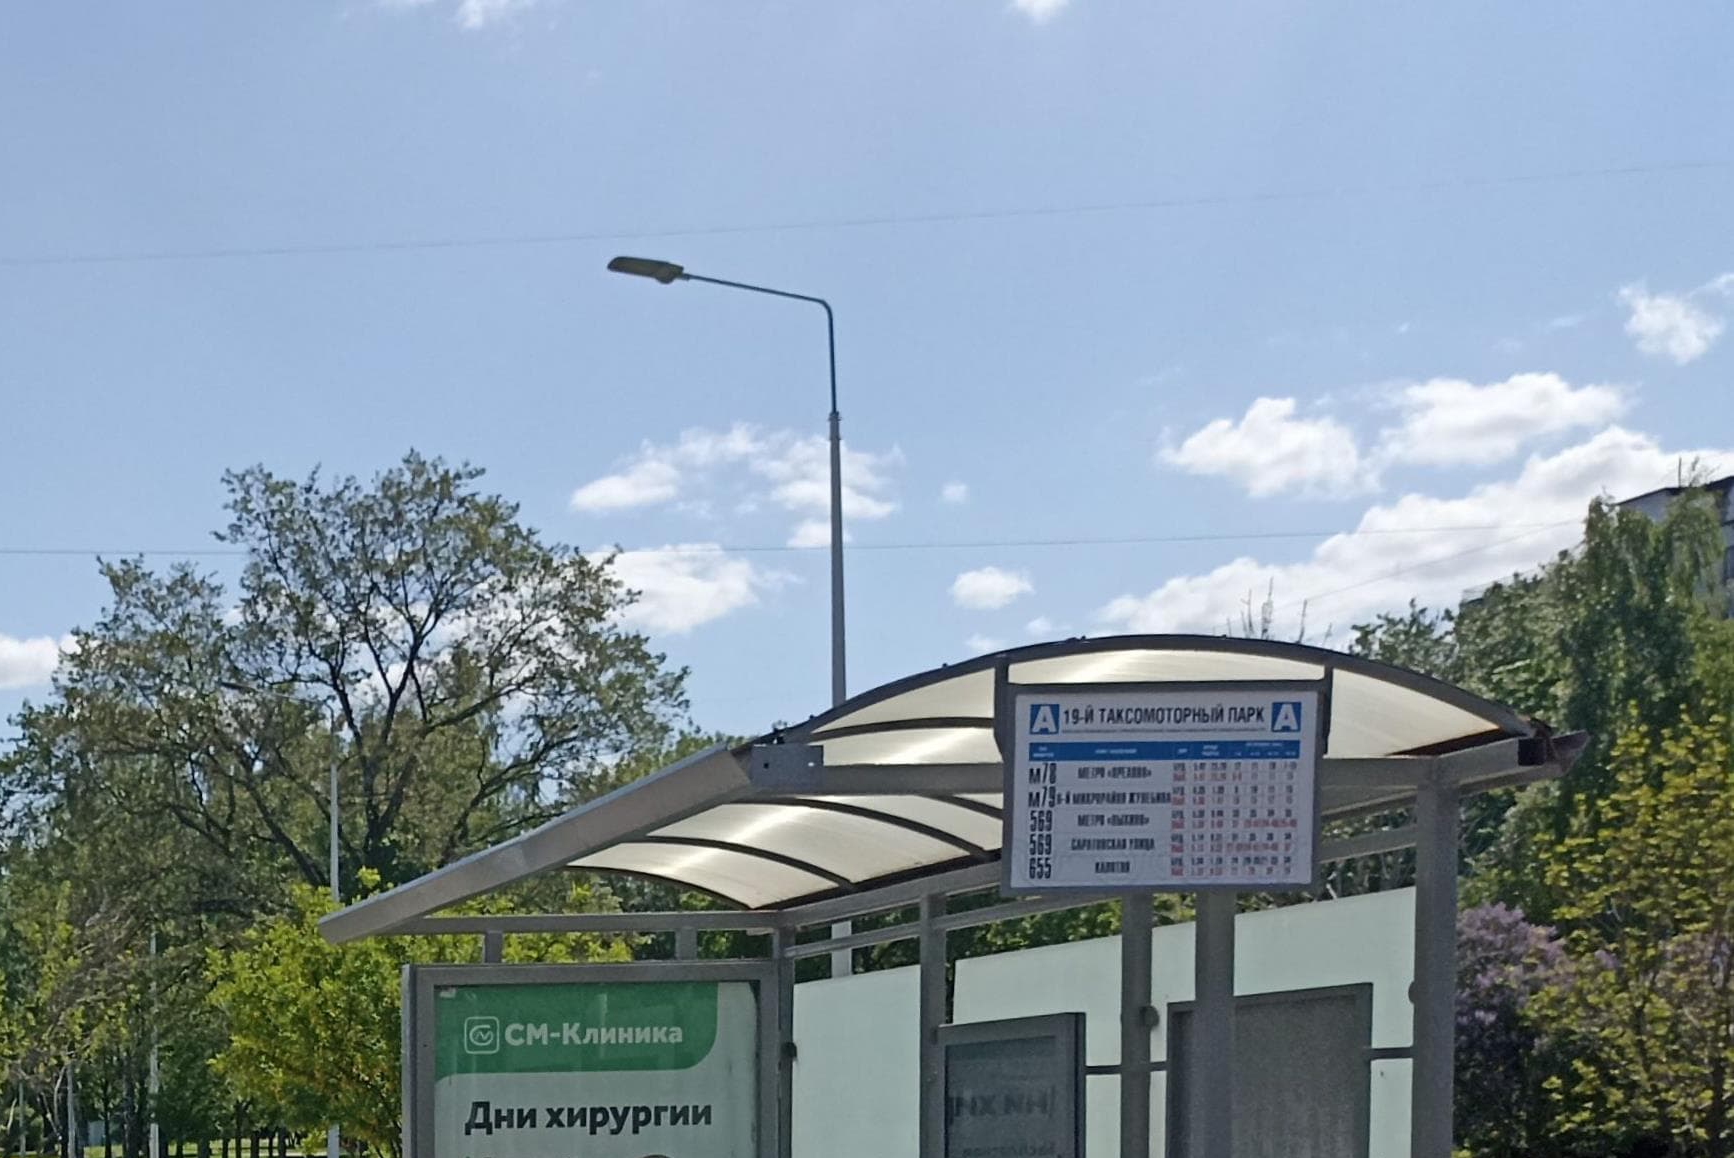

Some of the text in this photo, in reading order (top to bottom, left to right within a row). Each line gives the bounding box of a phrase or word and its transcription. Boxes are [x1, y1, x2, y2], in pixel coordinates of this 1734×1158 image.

[1063, 704, 1264, 724] 19-Й ТАКСОМОТОРНЫЙ ПАРК
[1030, 810, 1052, 832] 569
[1029, 834, 1052, 855] 569
[1029, 858, 1051, 879] 655
[504, 1021, 684, 1047] СМ-Клиника
[464, 1100, 712, 1136] Дни хирургии
